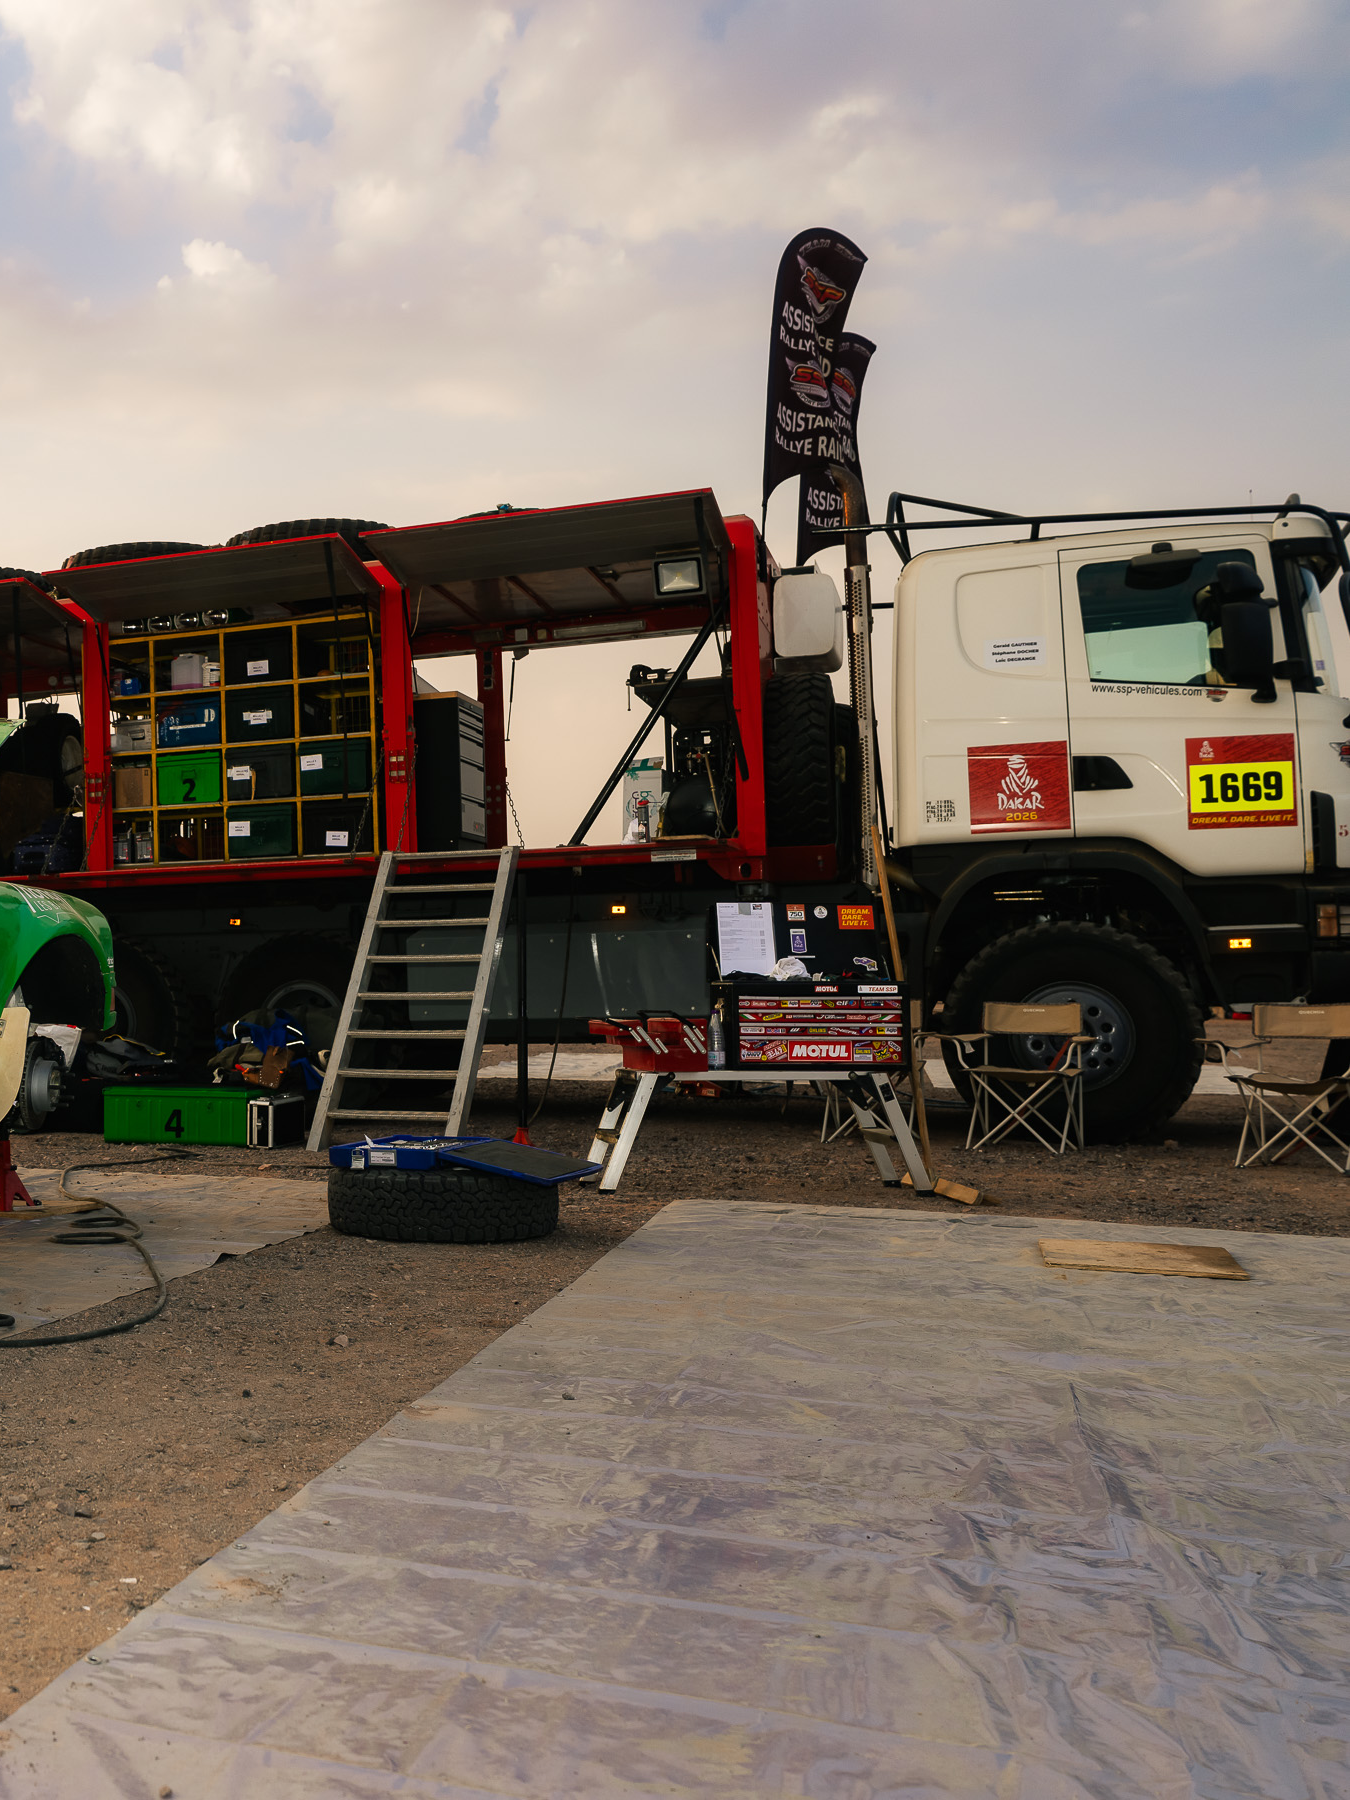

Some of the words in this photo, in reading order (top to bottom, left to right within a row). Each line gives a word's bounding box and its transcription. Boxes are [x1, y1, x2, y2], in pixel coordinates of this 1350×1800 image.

[1091, 684, 1203, 696] www.ssp-vehicules.com
[182, 778, 197, 802] 2
[1198, 771, 1284, 804] 1669
[997, 791, 1045, 811] DAKAR
[1005, 811, 1038, 822] 2026
[1192, 816, 1228, 824] DREAM.
[1229, 815, 1258, 823] DARE.
[1260, 814, 1281, 822] LIVE
[792, 1044, 849, 1058] MOTUL
[164, 1108, 185, 1139] 4
